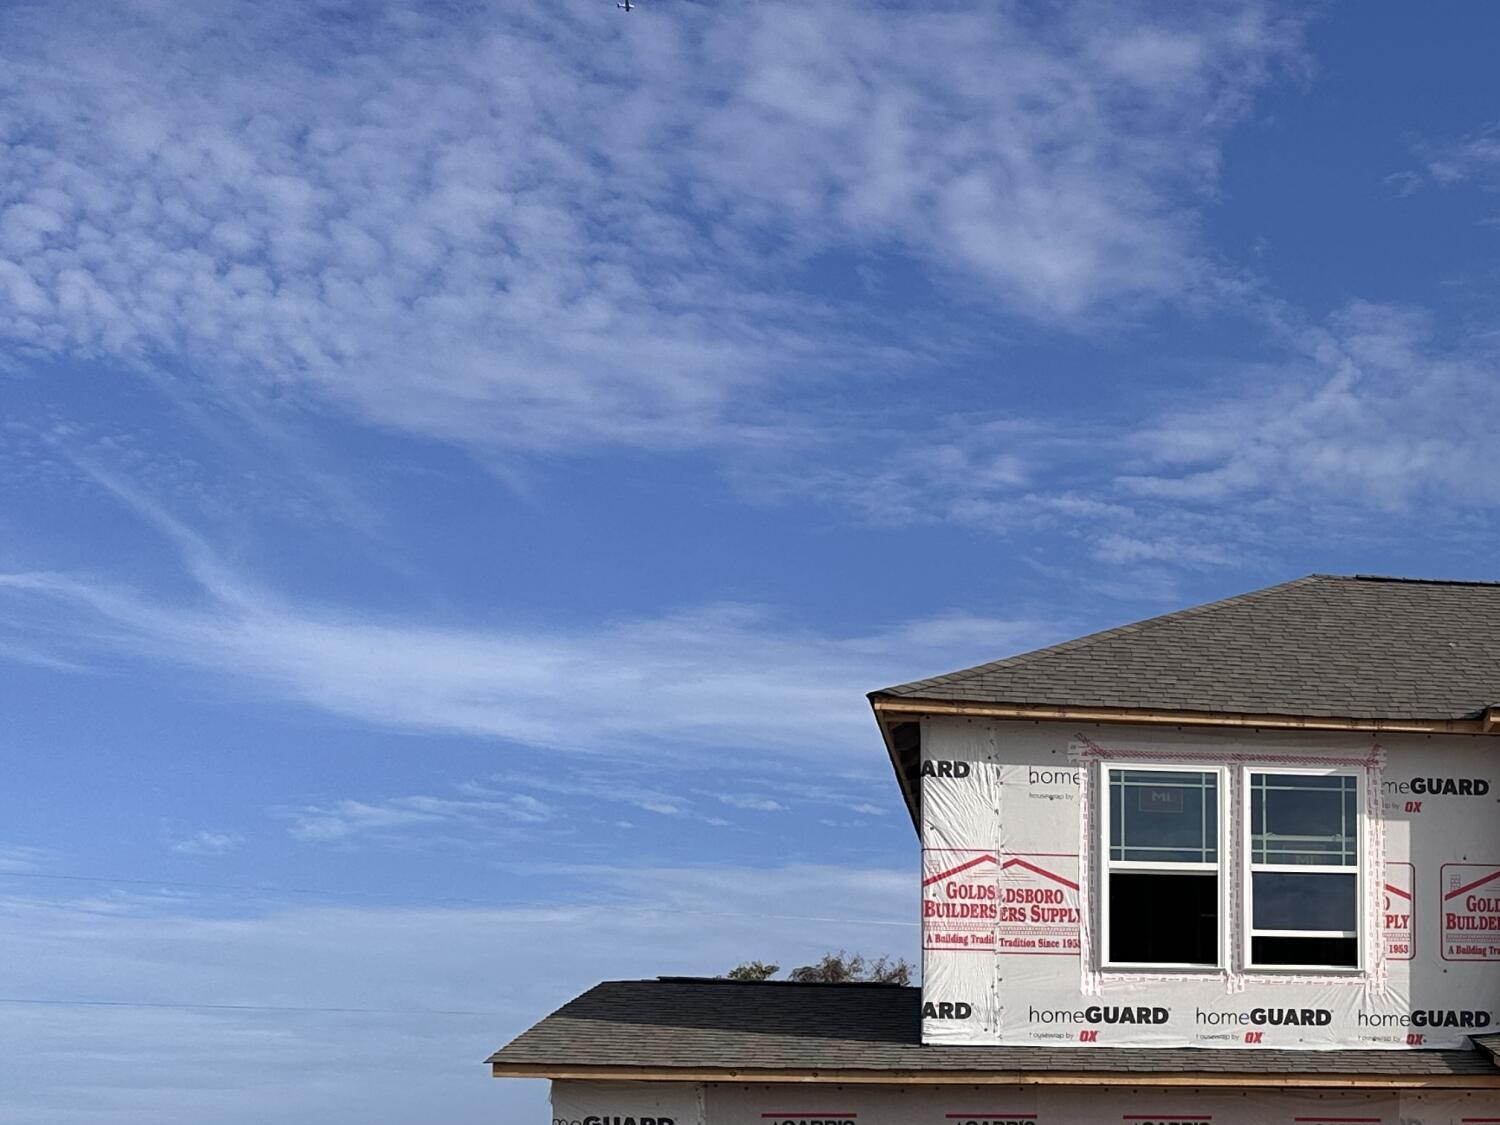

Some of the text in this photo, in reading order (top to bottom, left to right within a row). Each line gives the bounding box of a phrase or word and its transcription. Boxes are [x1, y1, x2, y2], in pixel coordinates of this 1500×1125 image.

[1405, 801, 1422, 813] OX
[924, 900, 997, 918] BUILDERS
[935, 934, 968, 945] Building
[1000, 938, 1060, 948] Tradition Since
[1389, 944, 1408, 954] 1953
[1456, 945, 1486, 957] Building
[1029, 1006, 1169, 1024] homeGUARD
[1196, 1007, 1332, 1026] homeGUARD
[1358, 1009, 1491, 1027] homeGUARD
[1079, 1030, 1098, 1042] OX
[1244, 1032, 1264, 1044] OX
[1406, 1033, 1424, 1045] OX
